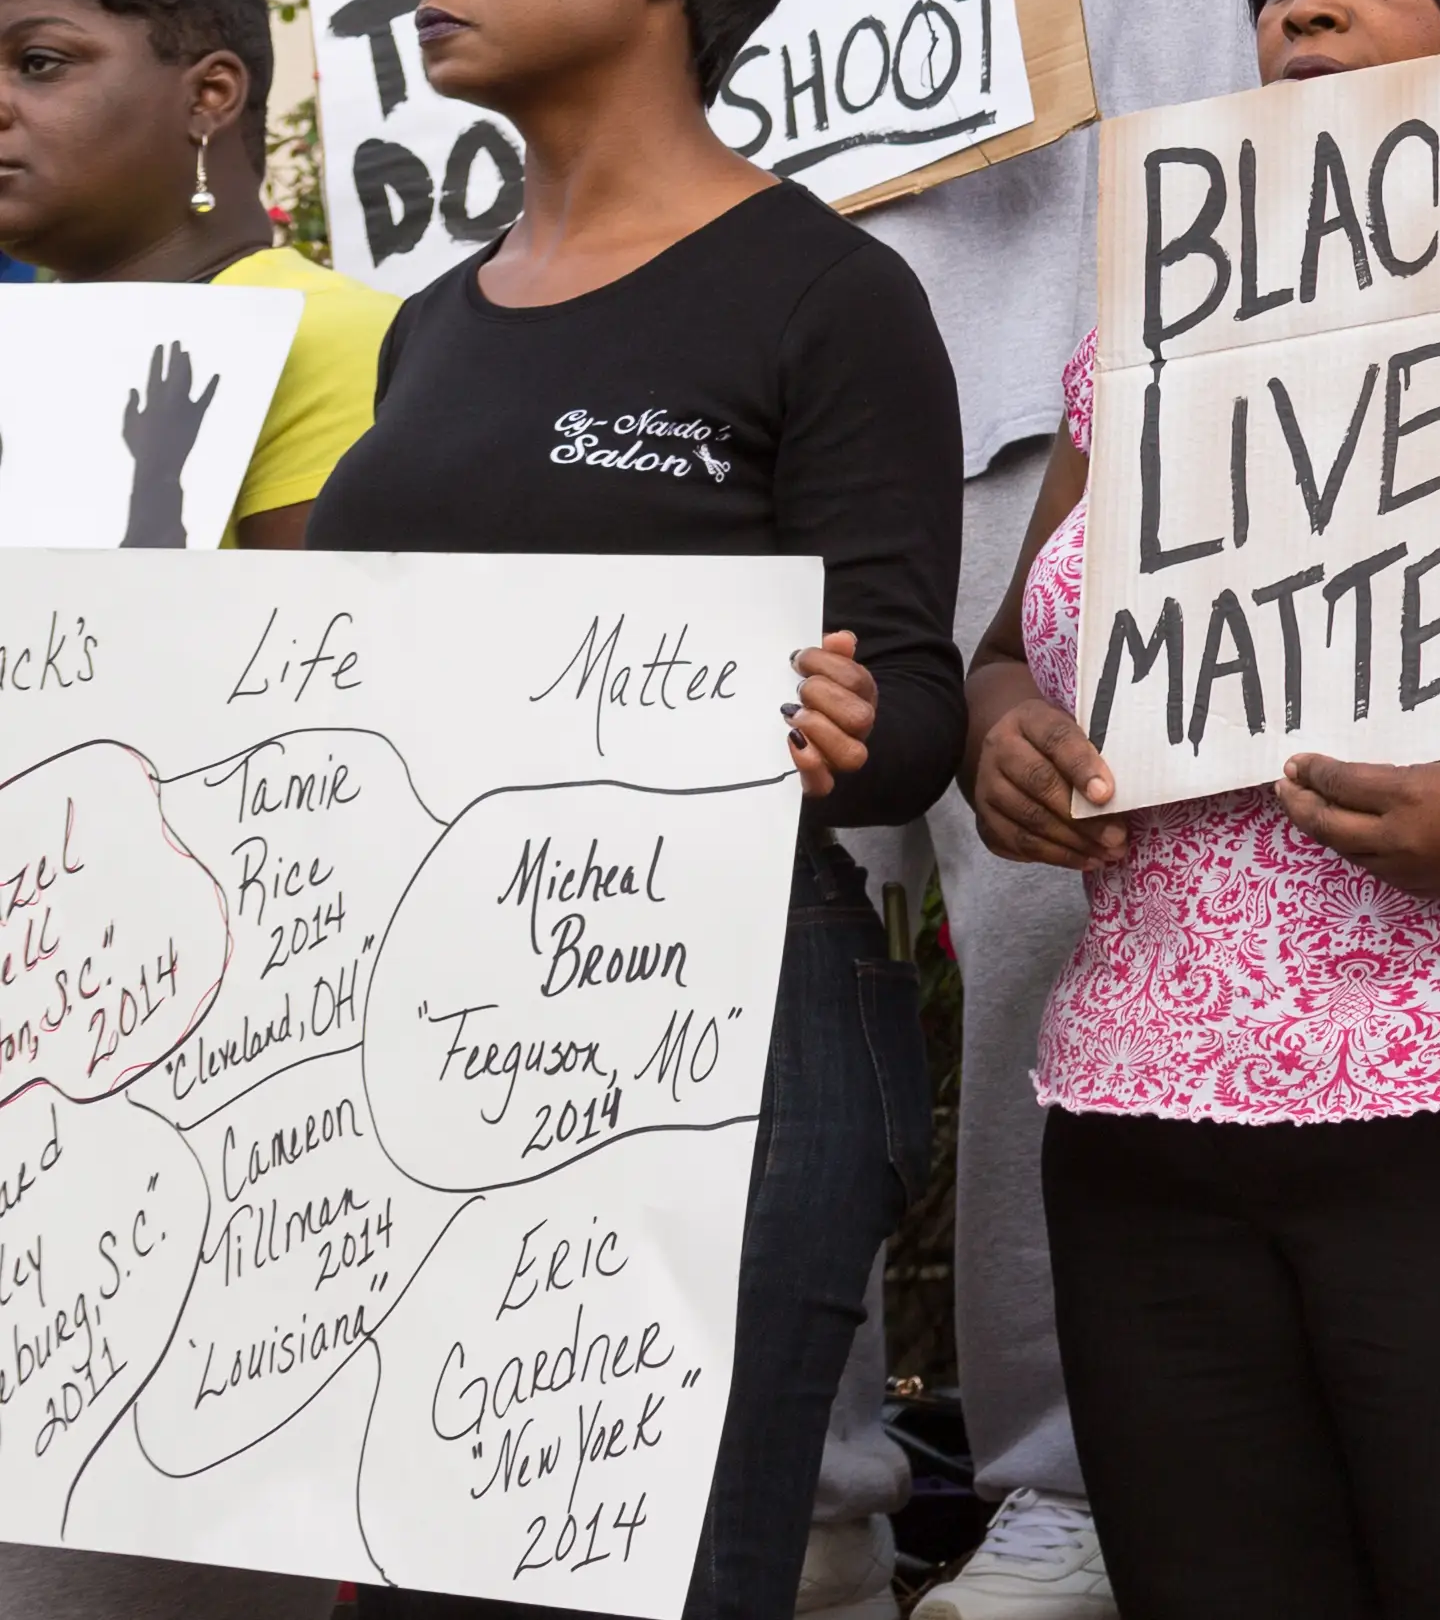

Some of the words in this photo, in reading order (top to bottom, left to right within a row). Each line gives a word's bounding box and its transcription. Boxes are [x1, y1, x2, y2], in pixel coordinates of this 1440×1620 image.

[550, 433, 691, 477] Salon
[0, 610, 98, 691] ck's
[227, 608, 362, 703] Life
[231, 836, 334, 925] Rice
[497, 836, 666, 955] Micheal
[260, 891, 346, 980] 2014
[87, 936, 178, 1078] 2014
[521, 1087, 623, 1158] 2014
[201, 1188, 369, 1286] Tillman
[316, 1198, 394, 1291] 2014
[512, 1492, 647, 1581] 2014
